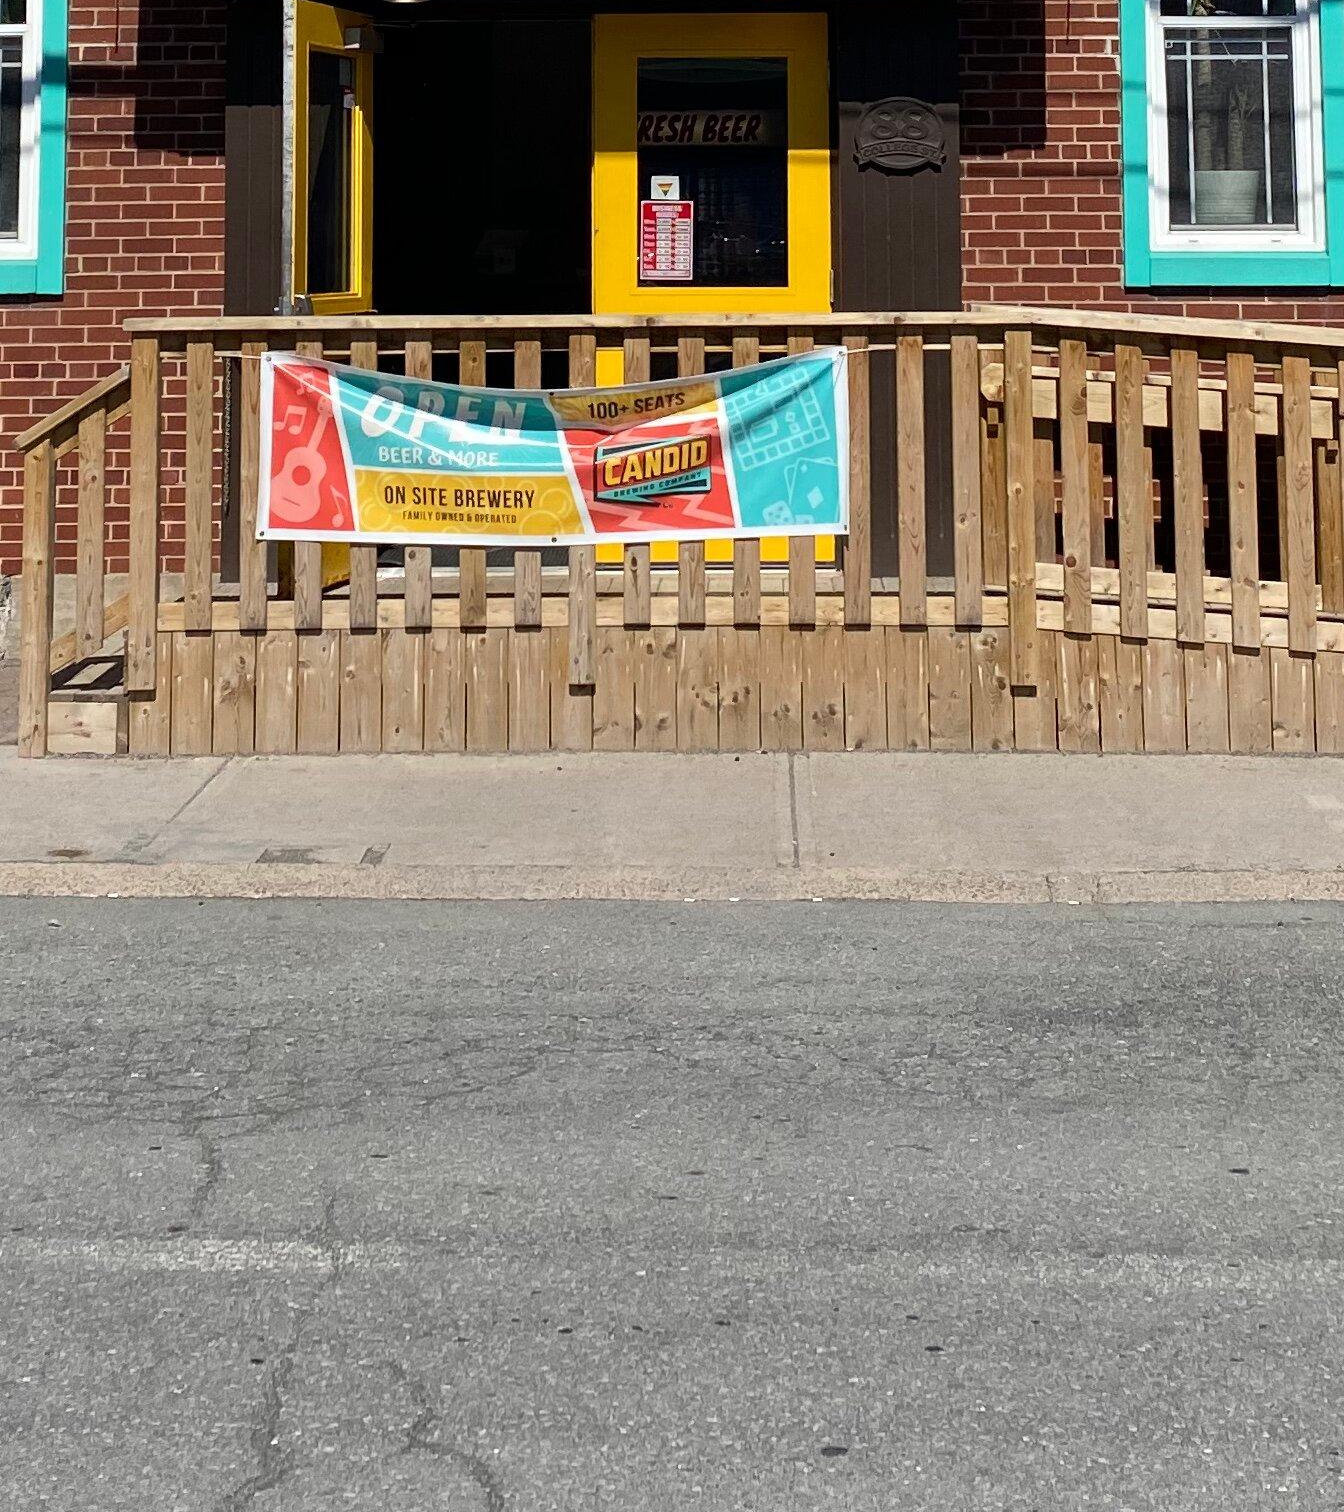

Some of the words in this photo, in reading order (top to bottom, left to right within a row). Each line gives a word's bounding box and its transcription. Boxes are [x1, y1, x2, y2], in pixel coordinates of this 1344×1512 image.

[636, 113, 698, 144] RESH
[702, 114, 762, 144] BEER
[361, 386, 526, 442] OPEN
[588, 402, 629, 419] 100+
[634, 392, 685, 413] SEATS
[379, 445, 423, 464] BEER
[428, 448, 442, 466] &
[448, 450, 499, 468] MORE
[603, 439, 708, 487] CANDID
[384, 485, 406, 504] ON
[413, 487, 447, 506] SITE
[454, 489, 535, 509] BREWERY
[613, 484, 655, 498] BREWING
[658, 471, 702, 487] COMPANY
[402, 510, 433, 521] FAMILY
[435, 512, 464, 522] OWNED
[474, 513, 517, 524] OPERATED
